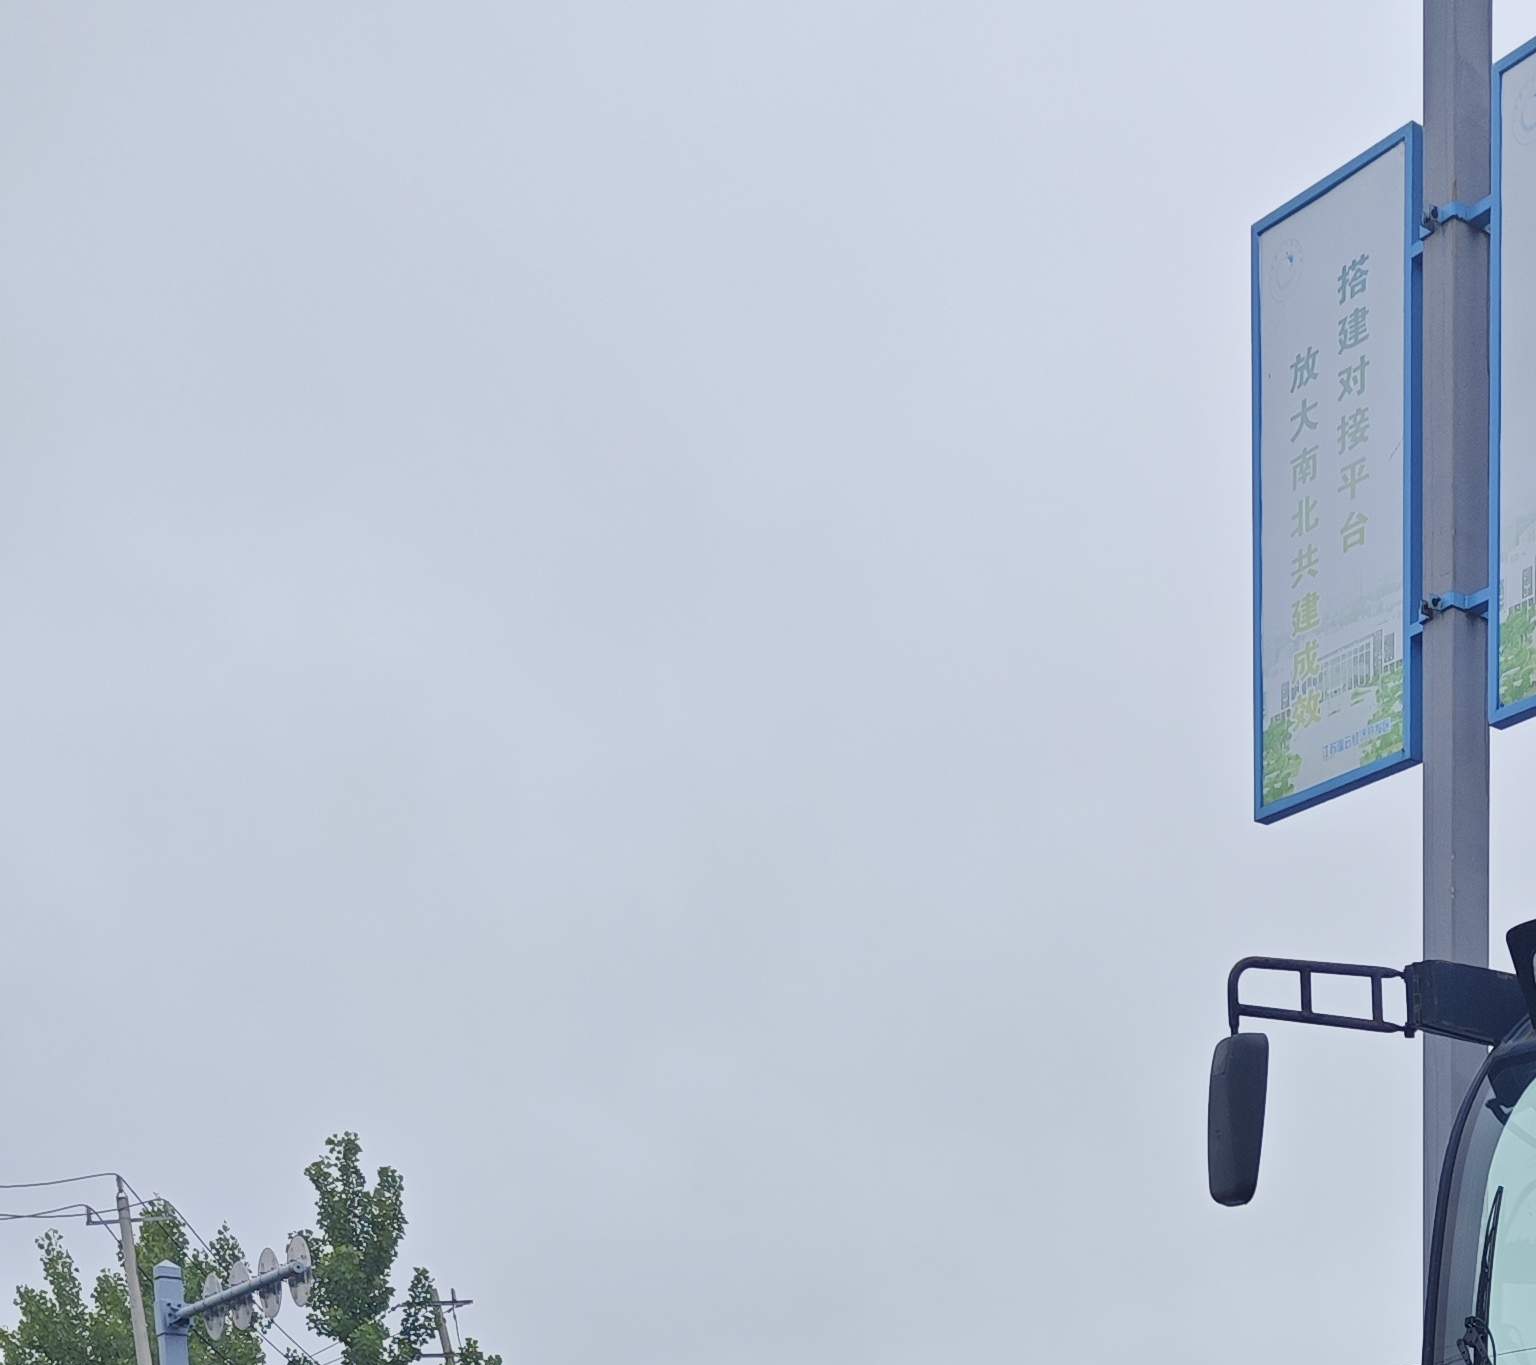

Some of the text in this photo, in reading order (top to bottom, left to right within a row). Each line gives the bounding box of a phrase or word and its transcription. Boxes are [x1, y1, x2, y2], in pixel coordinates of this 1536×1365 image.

[1290, 346, 1321, 730] 放大南北共建成效
[1338, 253, 1370, 554] 搭建对接平台
